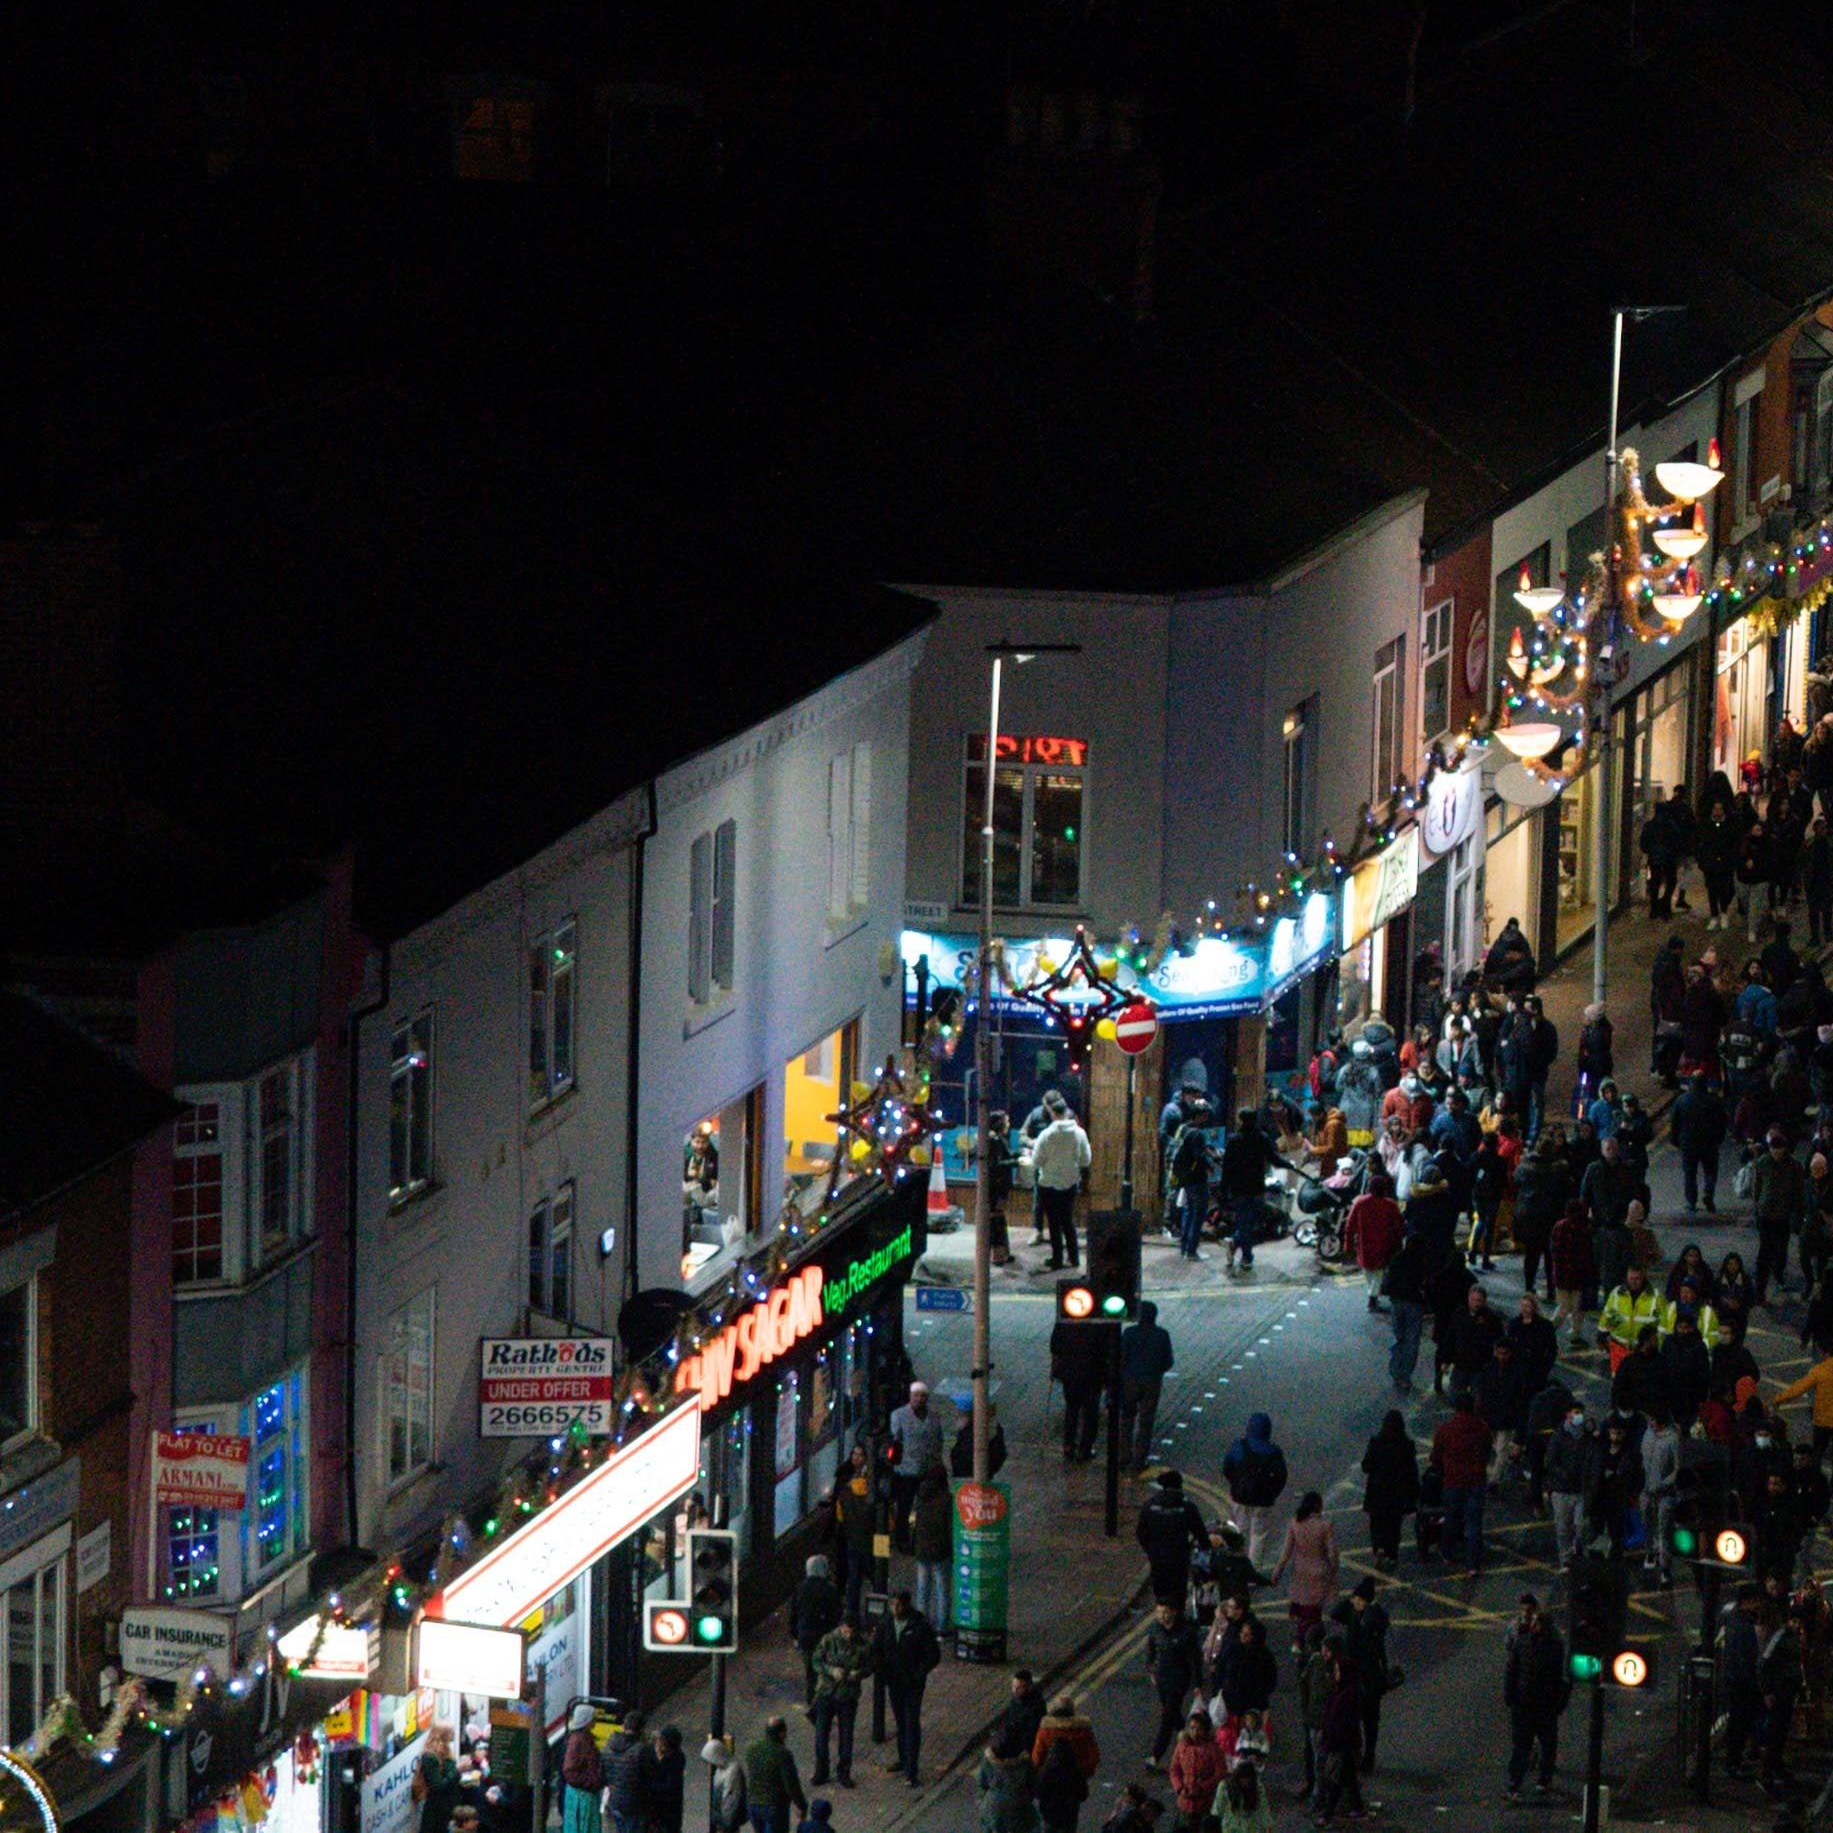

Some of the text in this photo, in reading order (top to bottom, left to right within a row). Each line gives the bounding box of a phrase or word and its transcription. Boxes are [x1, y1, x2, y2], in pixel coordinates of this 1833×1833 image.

[1011, 1002, 1046, 1014] Quality
[1187, 1005, 1209, 1016] Quality
[735, 1266, 824, 1381] SAGAR
[489, 1342, 605, 1364] Rathods
[488, 1365, 549, 1375] PROPERTY
[488, 1382, 591, 1399] UNDER OFFER
[489, 1406, 602, 1425] 2666575
[160, 1433, 244, 1459] FLAT TO LET
[161, 1468, 222, 1488] ARMANI
[963, 1507, 998, 1525] you
[125, 1623, 225, 1647] CAR INSURANCE
[374, 1754, 422, 1804] KAHLO
